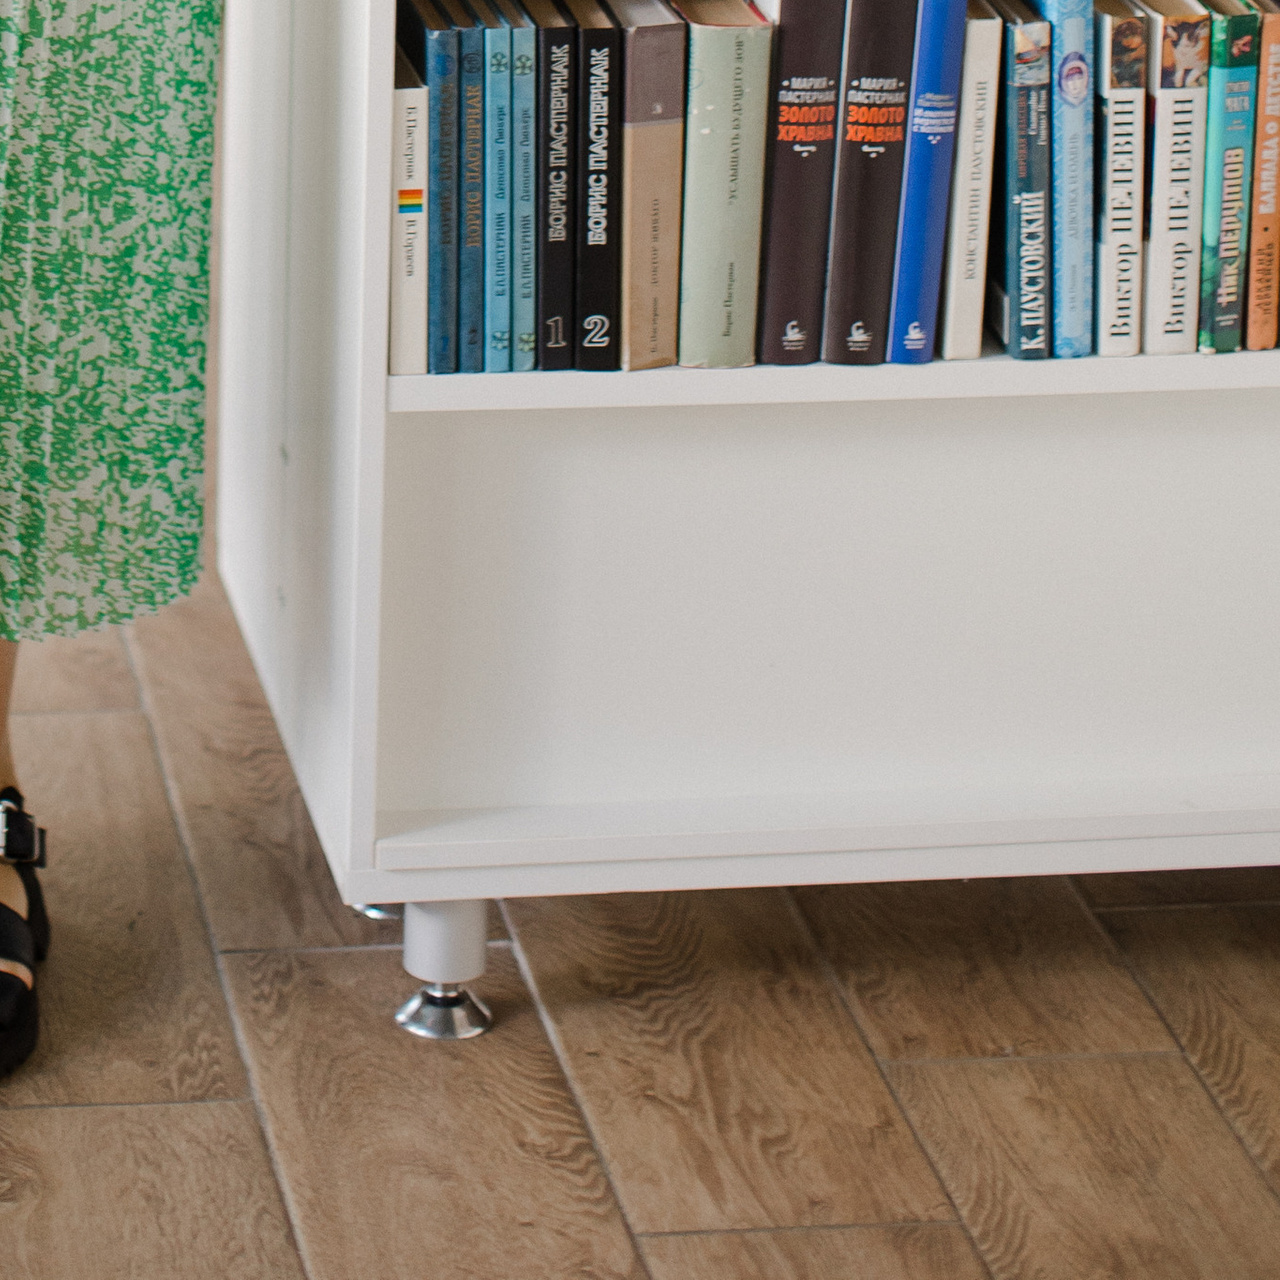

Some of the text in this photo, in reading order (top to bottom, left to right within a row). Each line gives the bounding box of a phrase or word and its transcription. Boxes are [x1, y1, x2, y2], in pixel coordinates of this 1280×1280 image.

[778, 91, 836, 103] ПАСТЕРНАК
[778, 105, 836, 123] ЗОЛОТО
[847, 90, 906, 104] ПАСТЕРНАК
[847, 105, 905, 124] ЗОЛОТО
[548, 44, 569, 241] БОРИС ПАСТЕРНАК
[587, 47, 609, 246] БОРИС ПАСТЕРНАК
[777, 125, 834, 142] ХРАВНА
[846, 125, 904, 142] ХРАВНА
[1265, 121, 1278, 135] О
[465, 85, 481, 247] БОРИС ПАСТЕРНАК
[965, 80, 988, 280] КОНСТАНТИН ПАУСТОВСКИЙ
[1259, 136, 1279, 215] БАЛЛАДА
[1110, 100, 1138, 337] Виктор ПЕЛЕВИН
[1164, 99, 1193, 334] Виктор ПЕЛЕВИН
[1219, 146, 1245, 259] ПЕРУМОВ
[1012, 191, 1046, 350] К. ПАУСТОВСКИЙ
[1216, 259, 1240, 307] Ник
[546, 316, 567, 347] 1
[582, 315, 610, 347] 2
